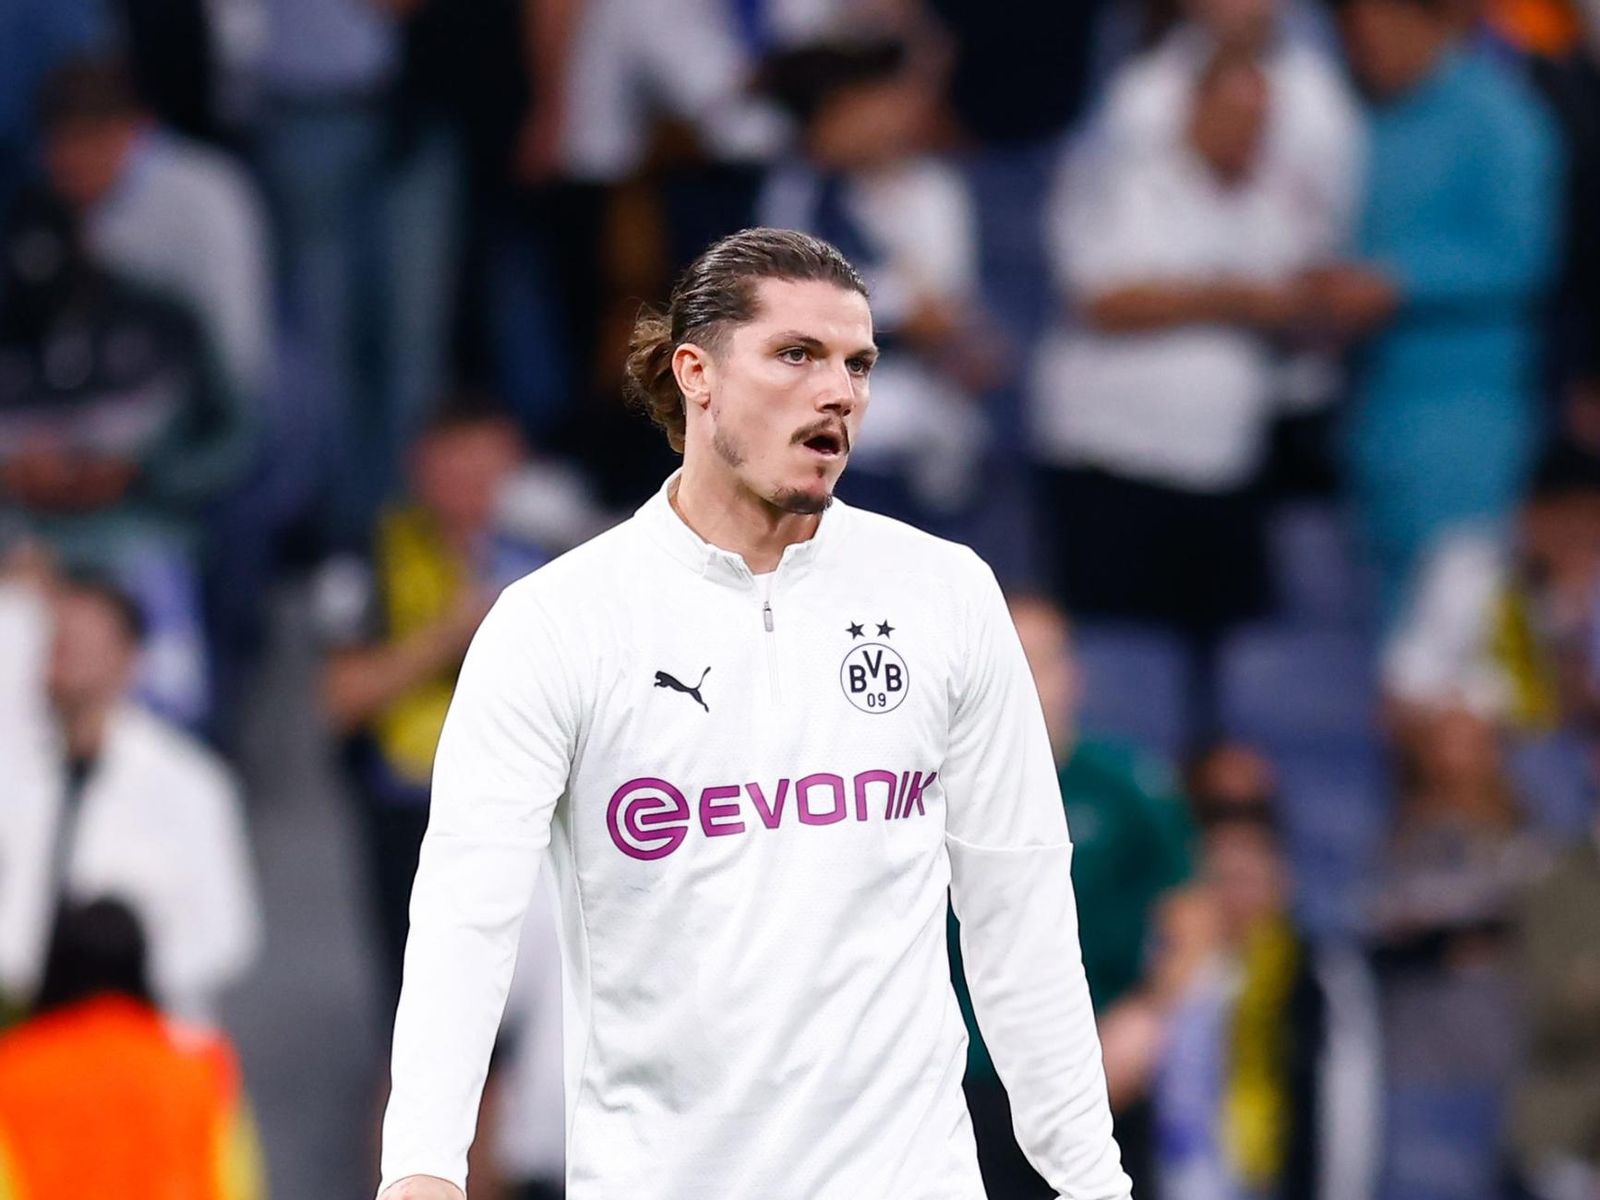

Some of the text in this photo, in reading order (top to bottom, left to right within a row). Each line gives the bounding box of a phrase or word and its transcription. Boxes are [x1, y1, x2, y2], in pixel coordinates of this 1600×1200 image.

[848, 649, 903, 693] BVB
[866, 692, 887, 708] 09
[699, 769, 938, 838] EVONIK
